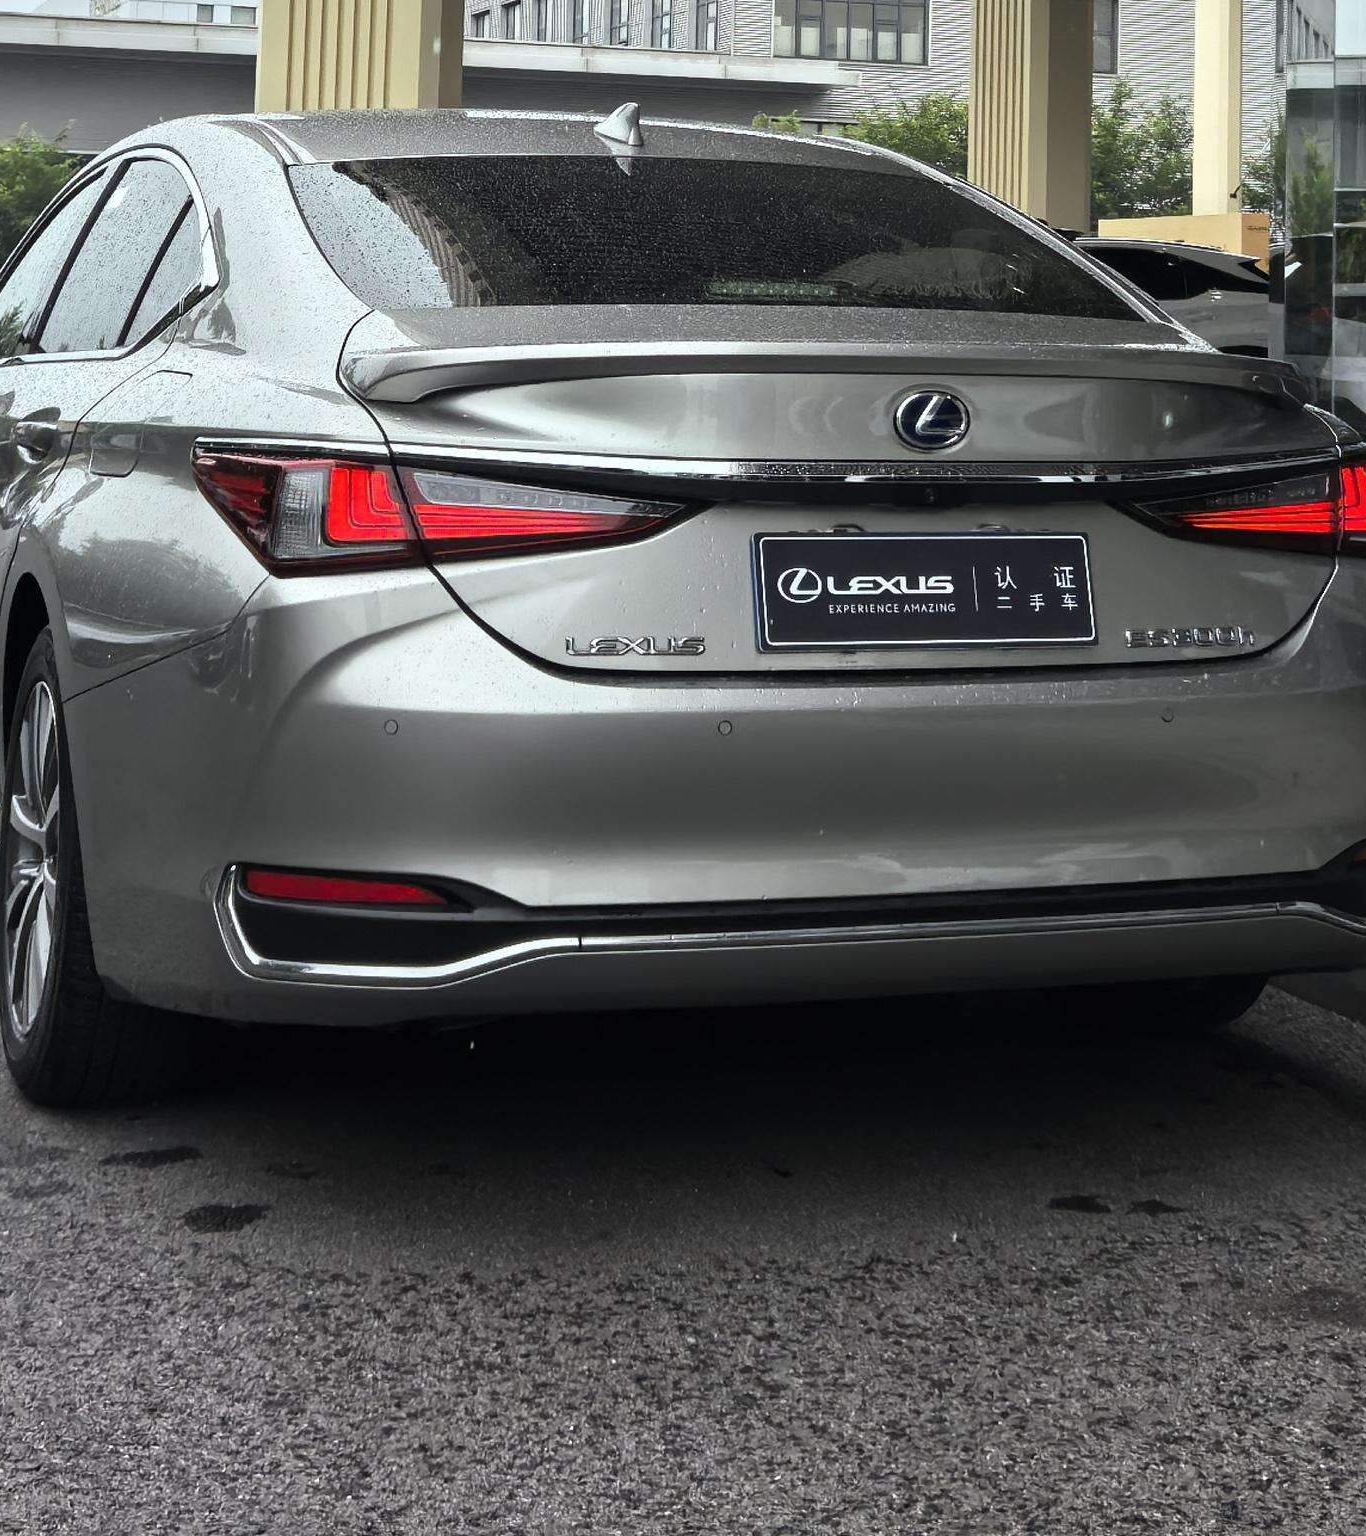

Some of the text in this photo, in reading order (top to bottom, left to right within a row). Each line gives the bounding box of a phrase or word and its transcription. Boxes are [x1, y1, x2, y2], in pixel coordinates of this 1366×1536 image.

[826, 575, 954, 595] LEXUS
[994, 566, 1076, 590] 认证
[828, 602, 956, 614] EXPERIENCE AMAZING
[996, 594, 1078, 612] 二手车
[565, 635, 706, 657] LEXUS
